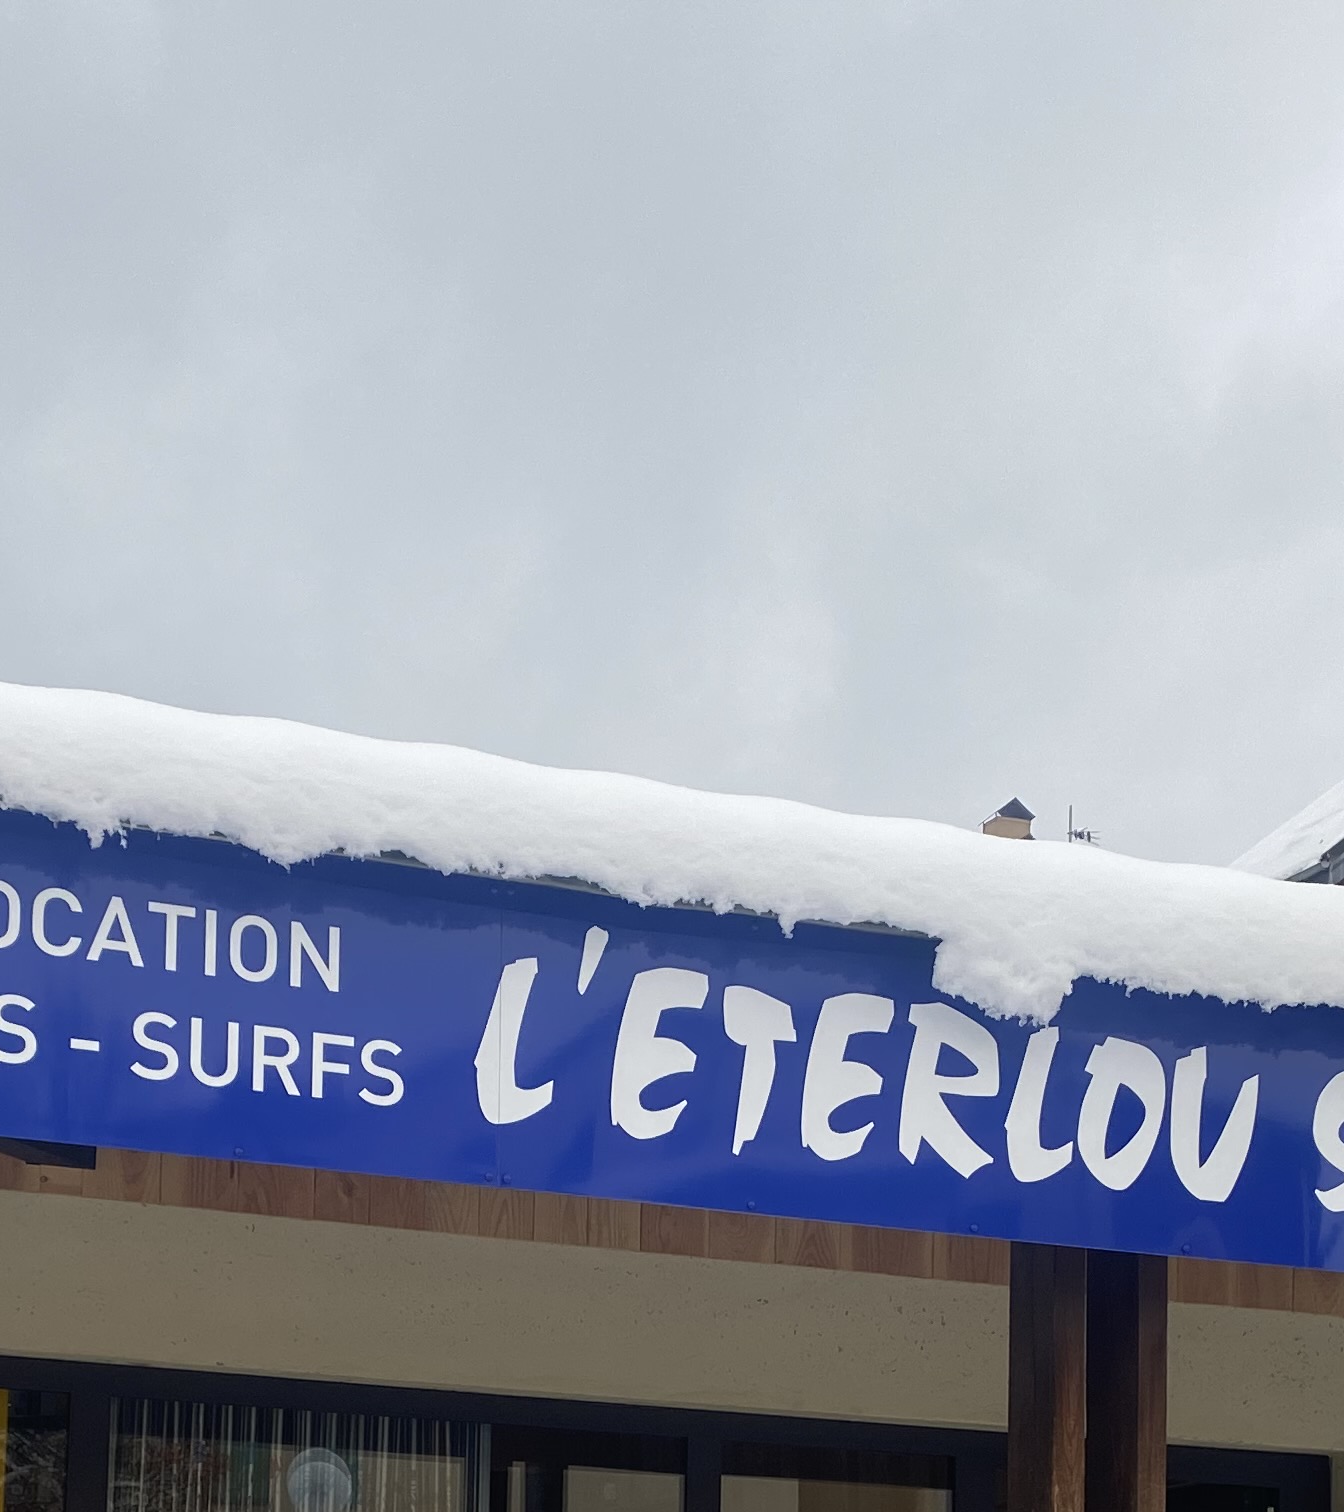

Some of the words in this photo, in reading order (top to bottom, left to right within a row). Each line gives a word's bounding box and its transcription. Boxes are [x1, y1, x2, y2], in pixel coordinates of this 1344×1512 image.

[69, 1037, 100, 1052] -
[129, 1011, 406, 1107] SURFS
[473, 925, 1259, 1203] L'ETERLOU
